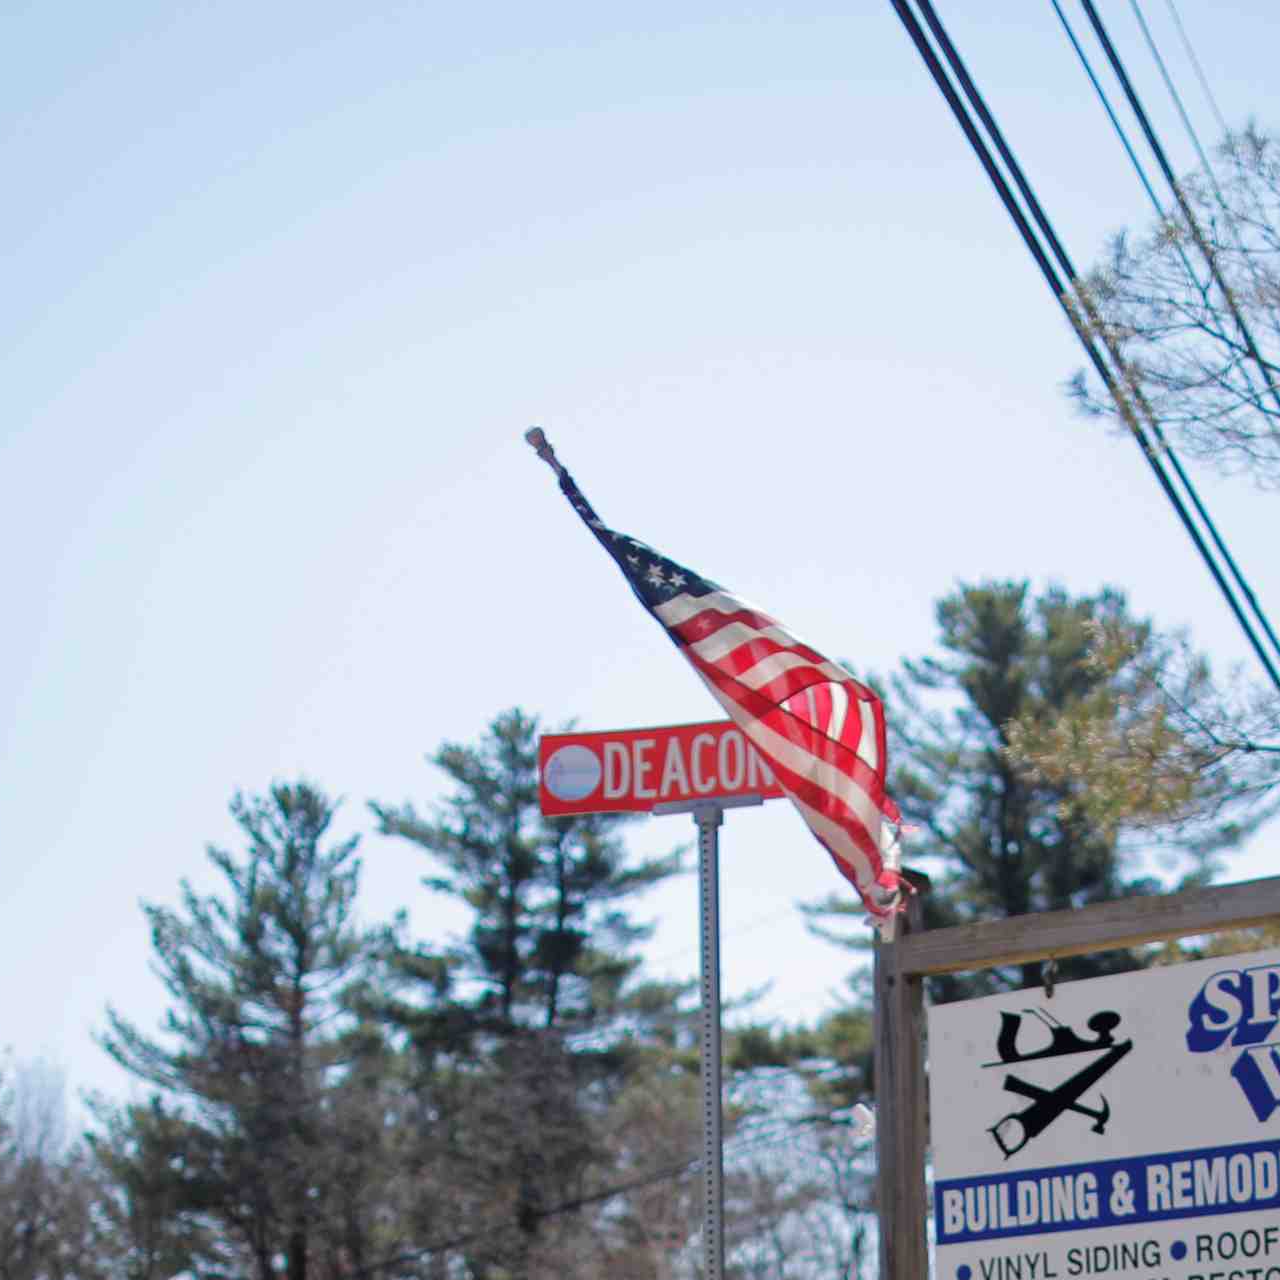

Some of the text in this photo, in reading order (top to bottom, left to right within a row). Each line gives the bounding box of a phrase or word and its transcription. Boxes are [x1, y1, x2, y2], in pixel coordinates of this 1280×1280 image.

[942, 1180, 1099, 1235] BUILDING
[1109, 1176, 1136, 1217] &
[1066, 1240, 1162, 1276] SIDING
